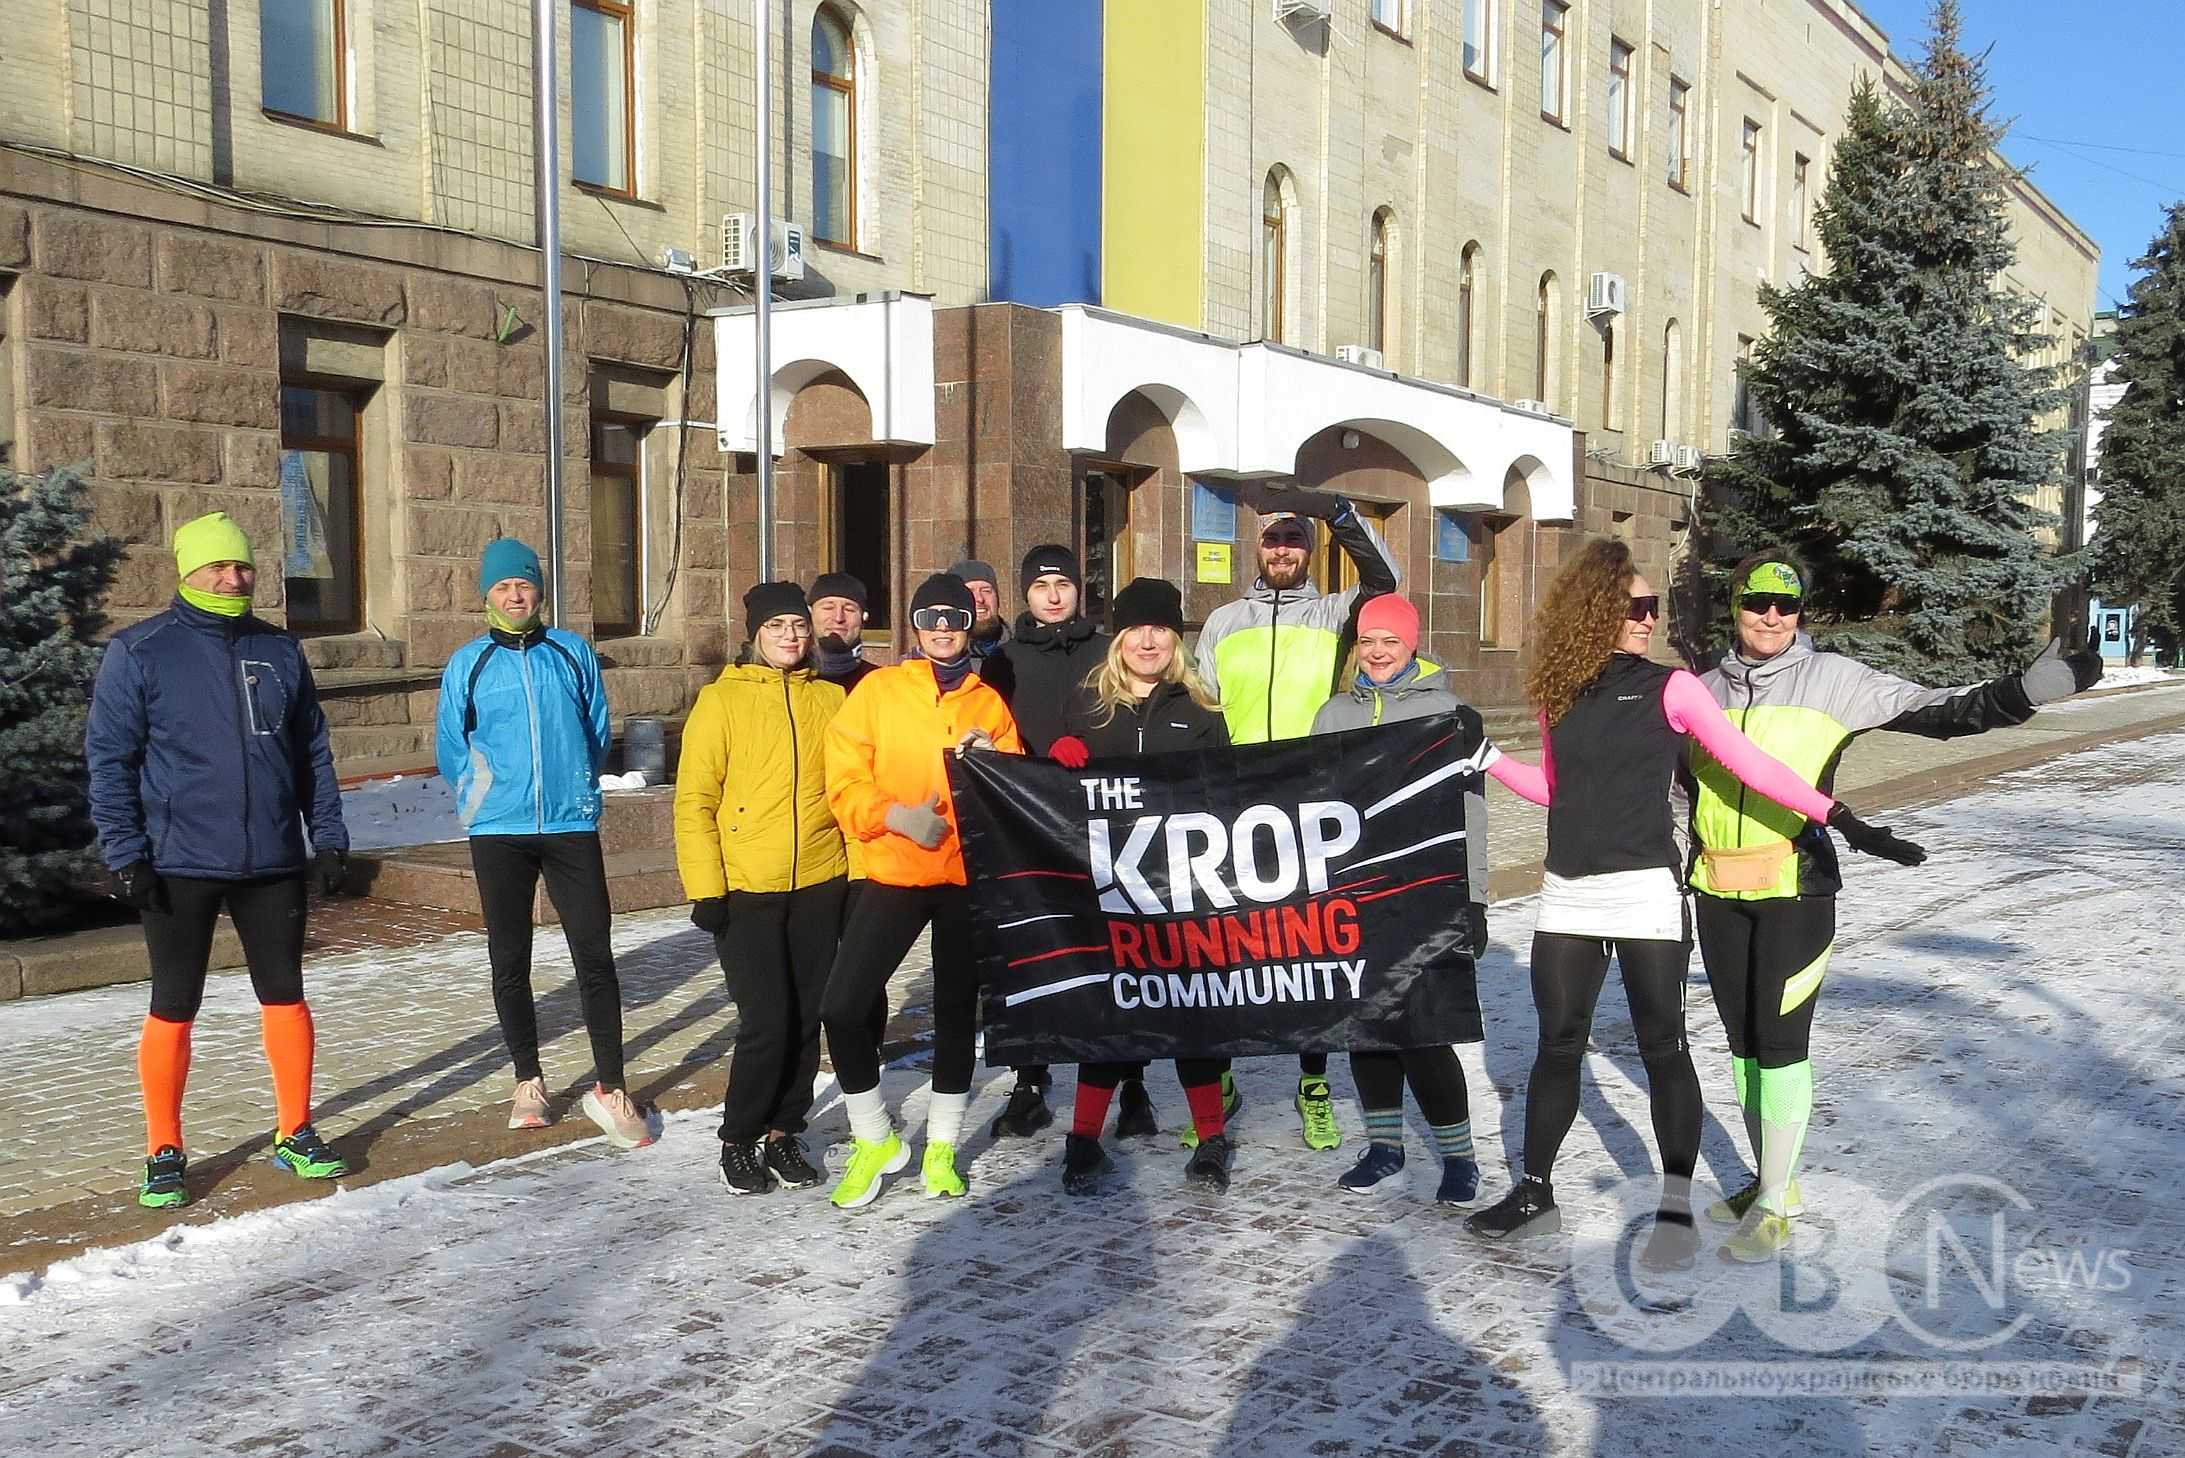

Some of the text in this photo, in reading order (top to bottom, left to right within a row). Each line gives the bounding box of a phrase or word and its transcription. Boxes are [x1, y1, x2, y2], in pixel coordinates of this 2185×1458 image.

[1080, 777, 1144, 810] THE
[1087, 800, 1361, 915] KROP
[1108, 899, 1361, 969] RUNNING
[1112, 959, 1367, 1010] COMMUNITY
